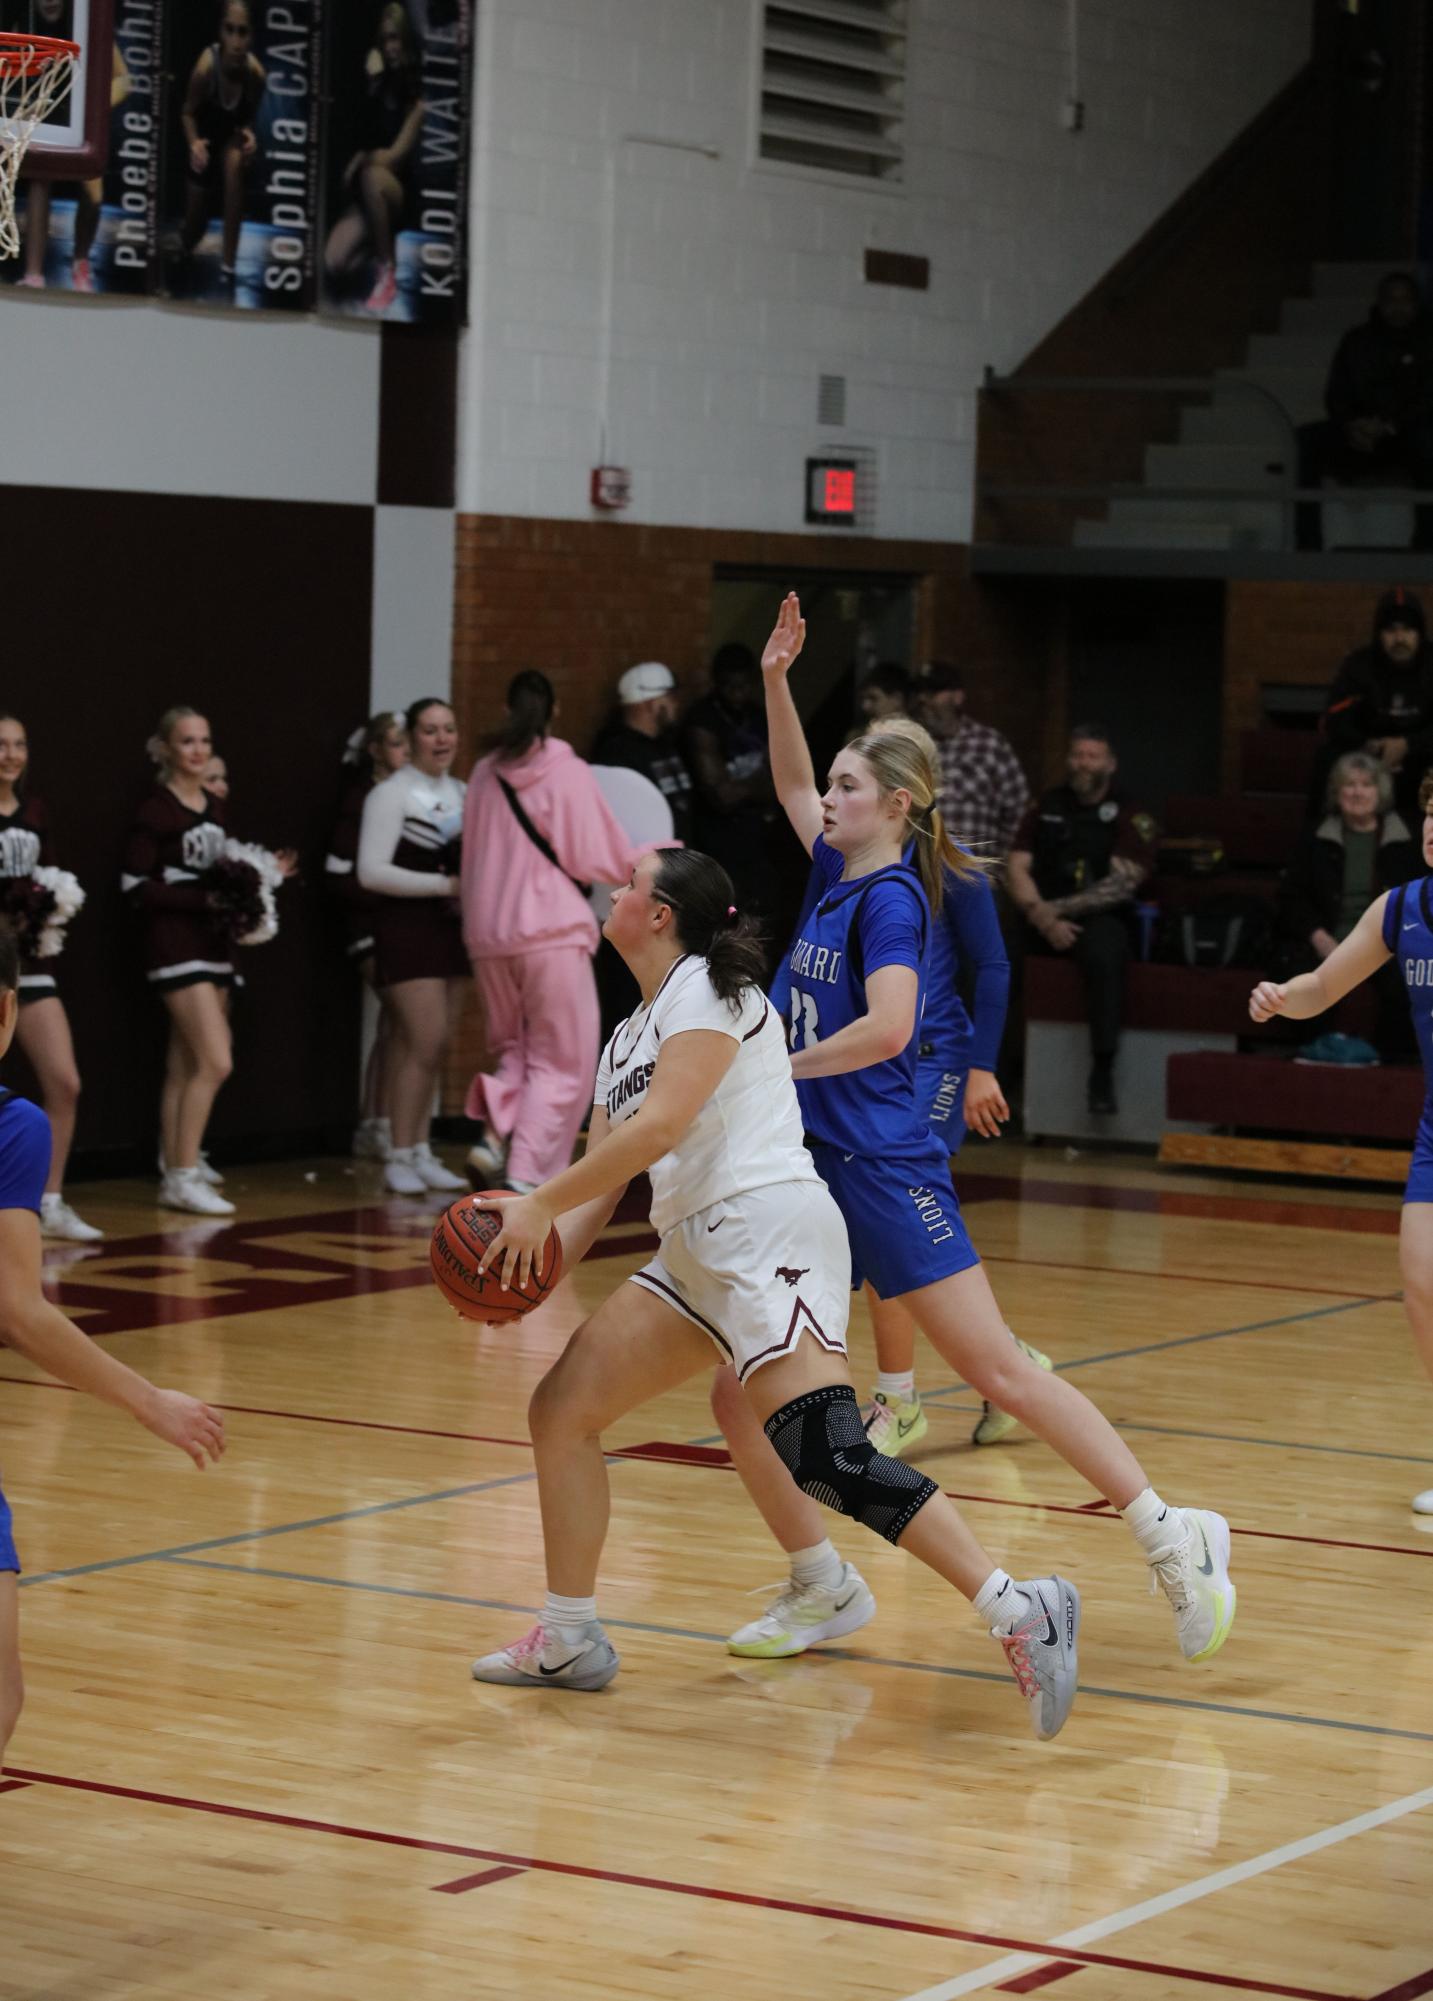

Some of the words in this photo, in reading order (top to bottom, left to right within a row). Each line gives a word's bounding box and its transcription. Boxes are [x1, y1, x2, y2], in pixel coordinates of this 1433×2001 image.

[266, 0, 309, 97] CAP
[114, 112, 152, 268] Phoebe
[264, 118, 311, 291] Sophia
[420, 189, 457, 296] KODI
[929, 1073, 961, 1122] LIONS
[908, 1186, 954, 1245] LIONS
